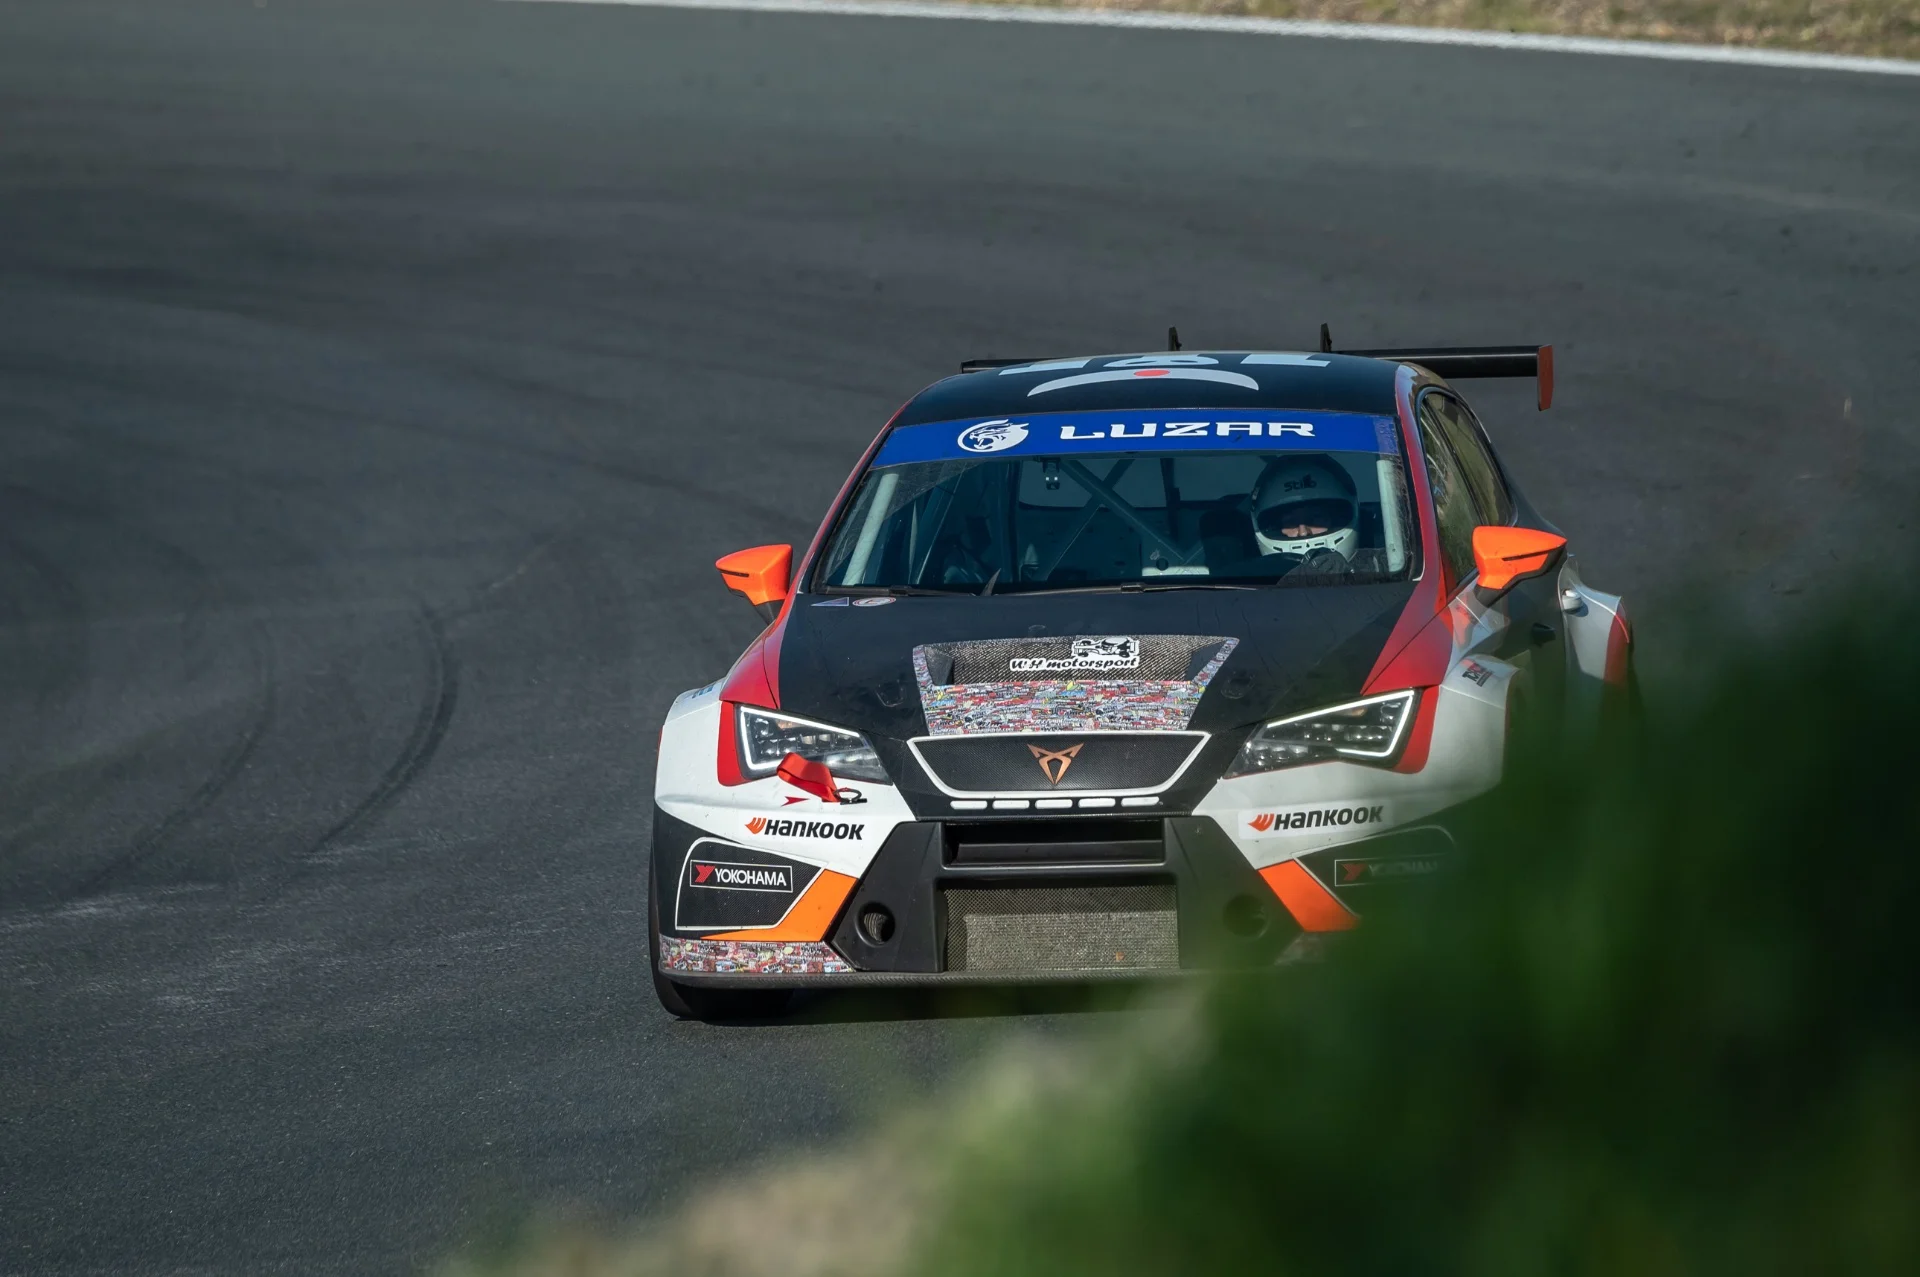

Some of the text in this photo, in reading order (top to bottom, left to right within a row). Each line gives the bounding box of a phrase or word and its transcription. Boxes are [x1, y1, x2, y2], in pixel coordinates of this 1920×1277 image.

[1060, 421, 1316, 440] LUZAR
[1046, 657, 1137, 669] motorsport
[715, 868, 787, 886] YOKOHAMA
